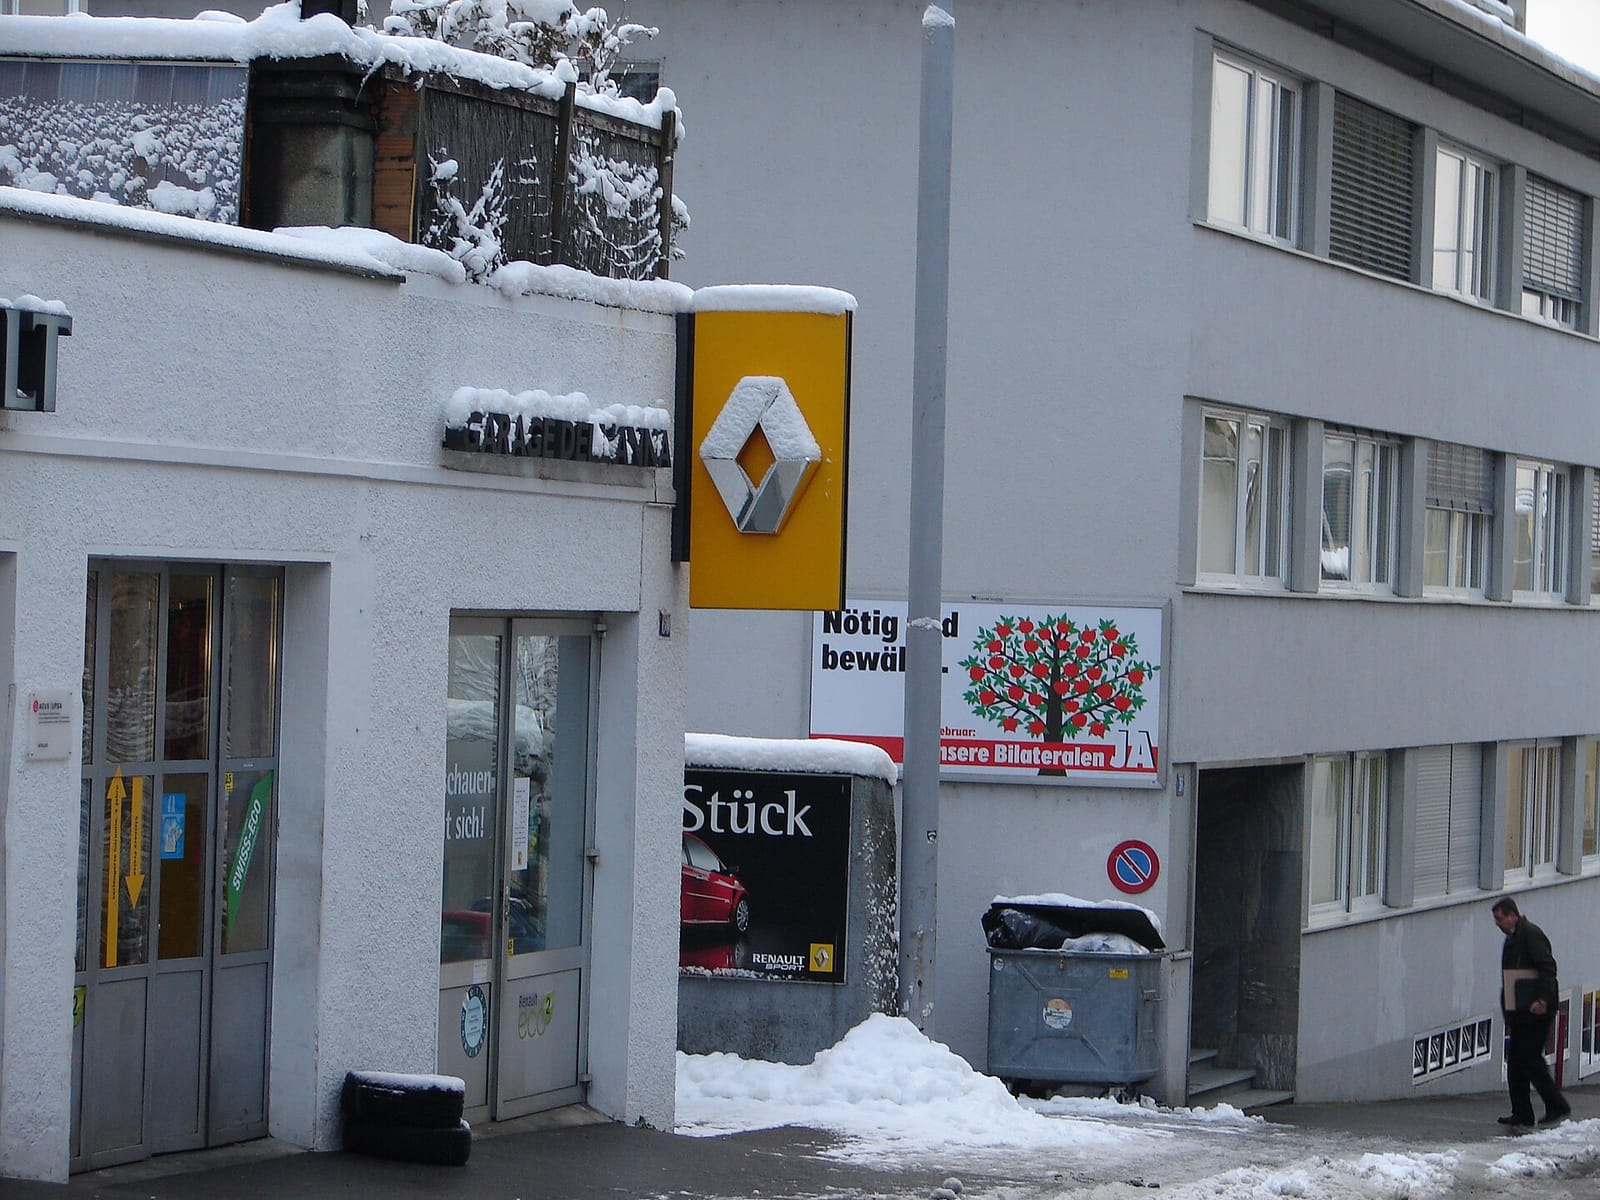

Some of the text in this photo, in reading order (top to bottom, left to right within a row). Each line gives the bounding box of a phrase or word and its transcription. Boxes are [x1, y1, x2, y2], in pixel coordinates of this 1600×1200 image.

[456, 411, 556, 458] GARAGE
[823, 609, 898, 643] Nötig
[940, 726, 976, 737] ebruar:
[994, 743, 1105, 767] Bilateralen
[1110, 729, 1156, 769] JA
[455, 805, 485, 839] sich!
[682, 784, 813, 837] Stück
[232, 799, 262, 891] SWISS-ECO
[752, 953, 806, 965] RENAULT
[765, 963, 805, 972] SPORT
